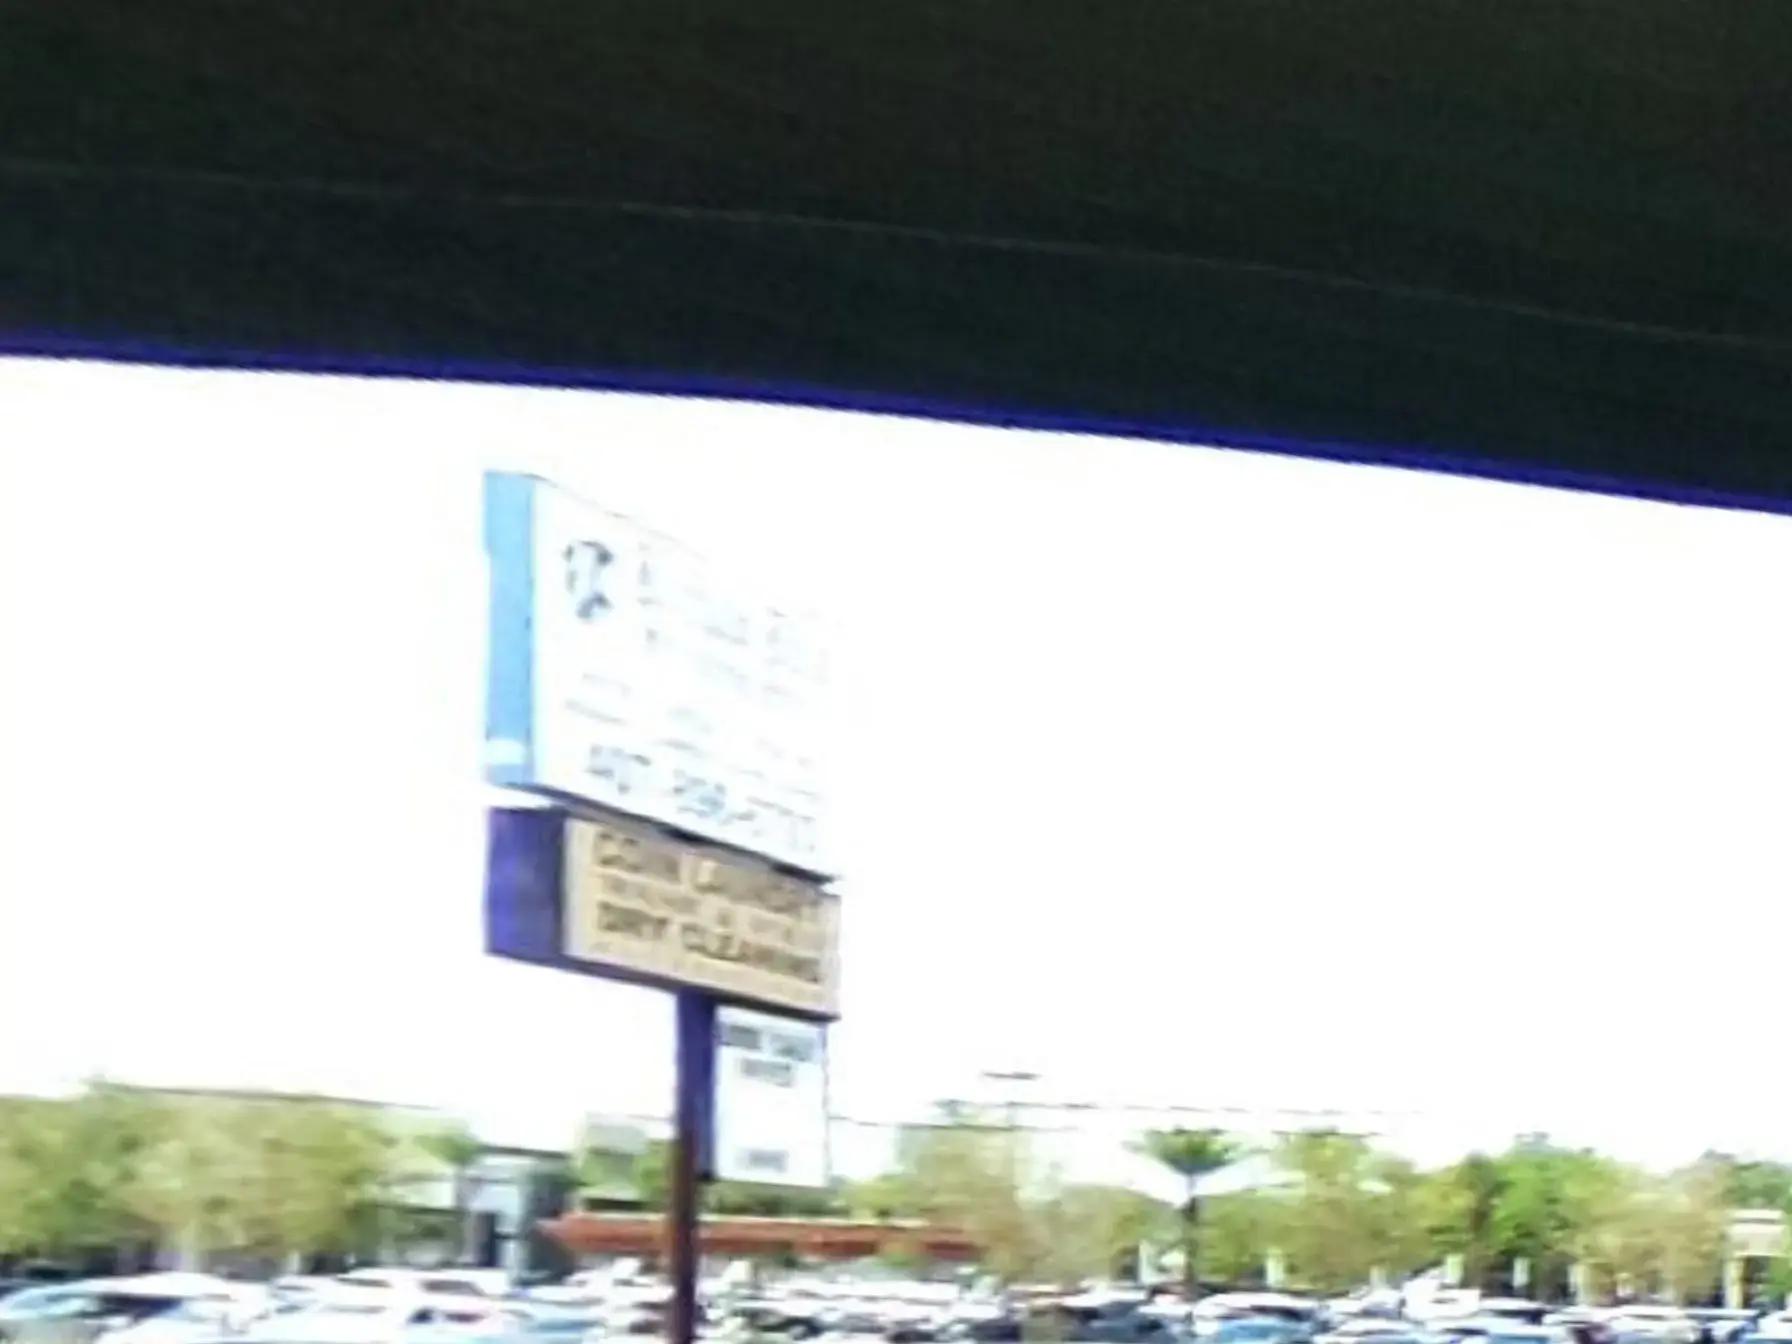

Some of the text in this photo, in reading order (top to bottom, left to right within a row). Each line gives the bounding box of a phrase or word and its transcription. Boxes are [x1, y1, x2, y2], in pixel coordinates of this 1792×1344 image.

[595, 829, 682, 882] COIN
[690, 856, 824, 915] LAUNDRY
[596, 899, 671, 942] DRY
[678, 919, 825, 984] CLEANING
